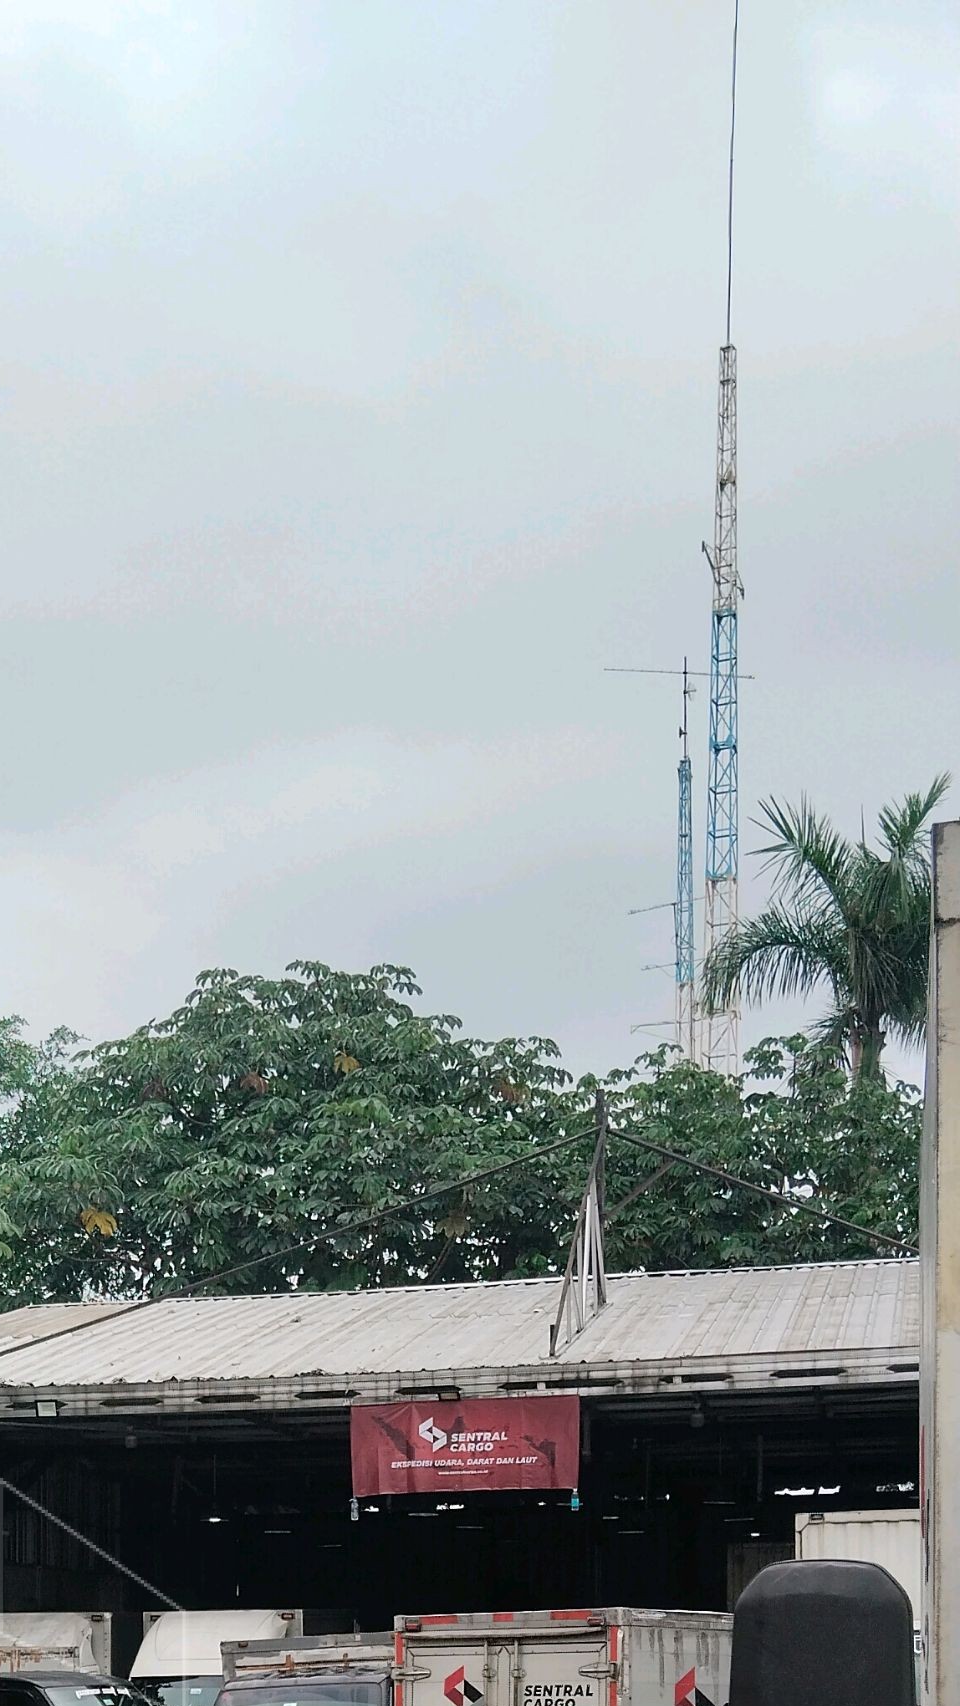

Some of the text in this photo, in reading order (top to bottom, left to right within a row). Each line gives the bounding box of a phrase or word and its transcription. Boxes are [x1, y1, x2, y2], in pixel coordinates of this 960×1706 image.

[451, 1431, 508, 1443] SENTRAL
[450, 1442, 494, 1452] CARGO
[391, 1456, 538, 1469] EKSPEDISI UDARA, DARAT DAN LAUT
[523, 1684, 594, 1697] SENTRAL
